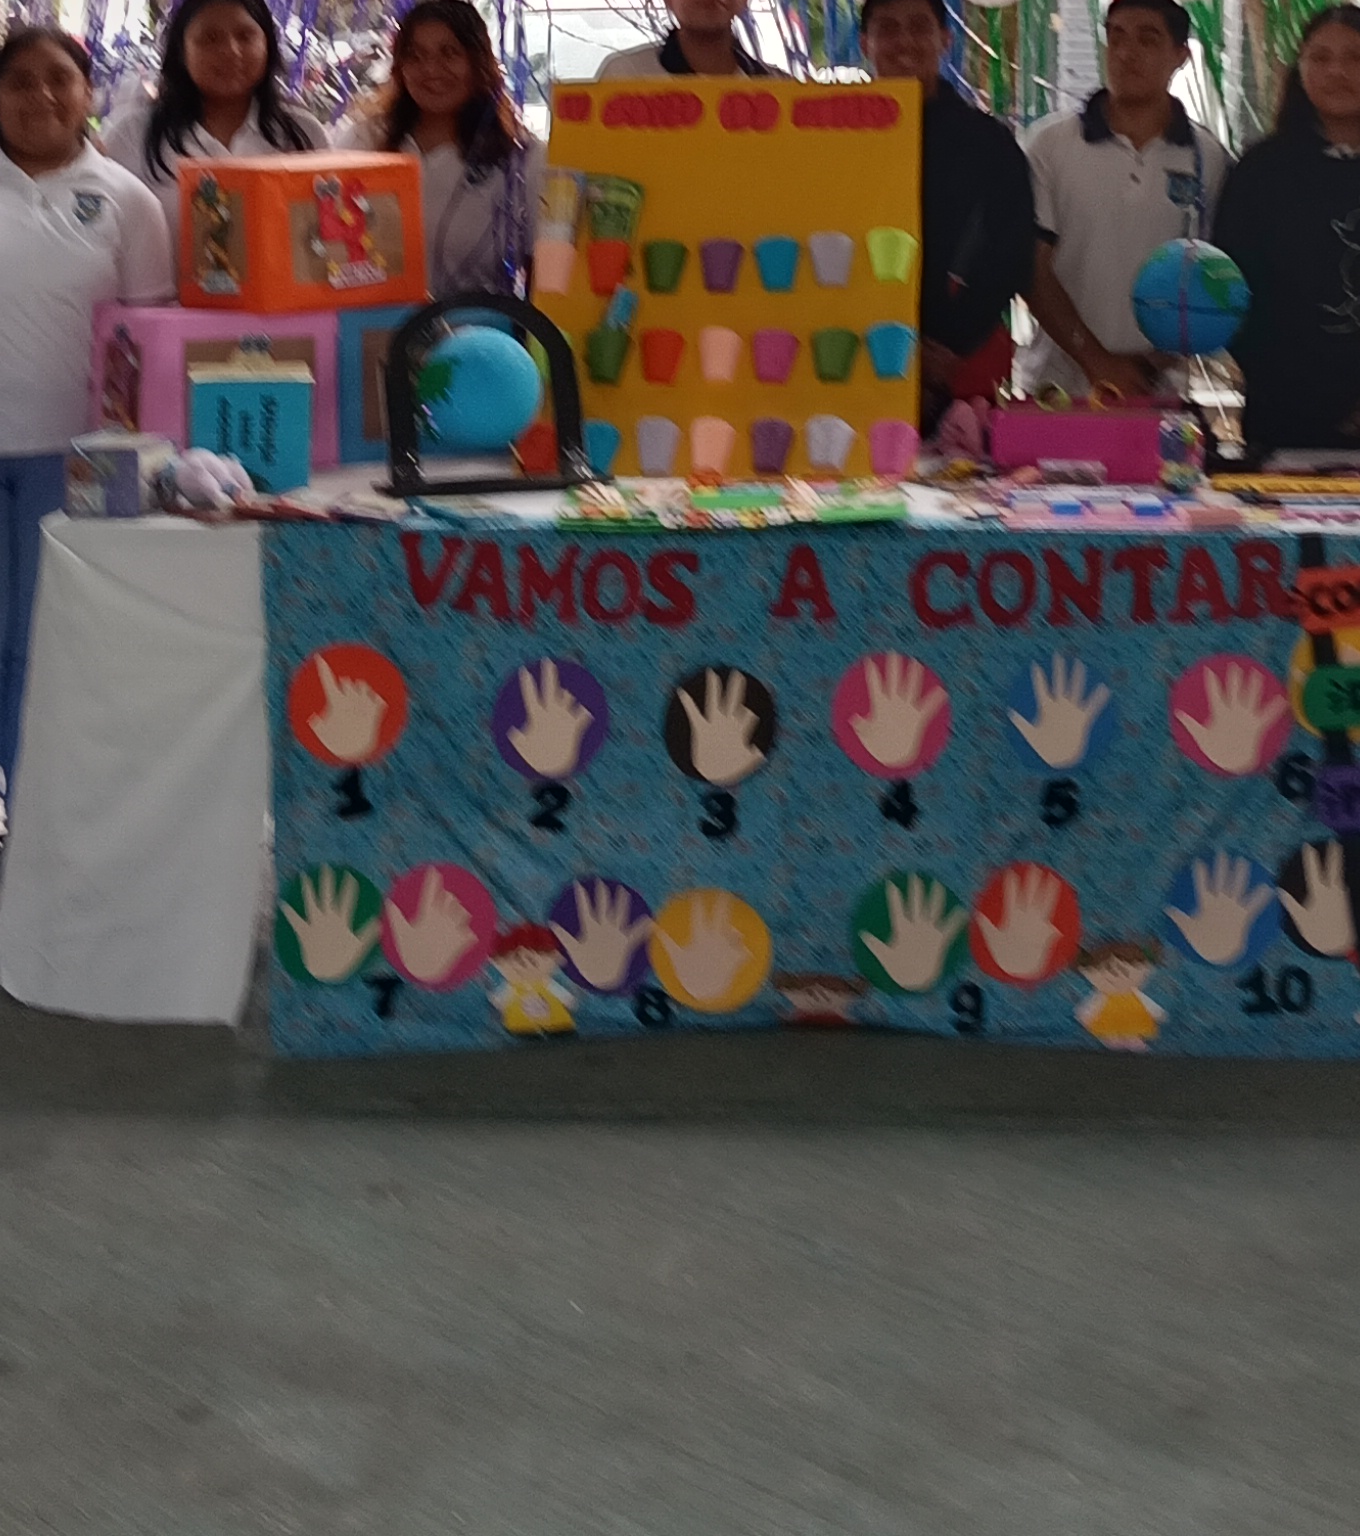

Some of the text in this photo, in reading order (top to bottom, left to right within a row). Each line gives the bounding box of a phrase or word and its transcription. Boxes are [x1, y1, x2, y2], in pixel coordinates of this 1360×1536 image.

[400, 532, 1300, 630] VAMOS A CONTAR
[331, 766, 374, 818] 1
[879, 778, 919, 829] 4
[1041, 777, 1079, 828] 5
[1274, 752, 1317, 809] 6
[529, 781, 571, 832] 2
[699, 790, 736, 838] 3
[364, 973, 403, 1020] 7
[635, 985, 675, 1028] 8
[949, 981, 984, 1034] 9
[1238, 965, 1313, 1016] 10
